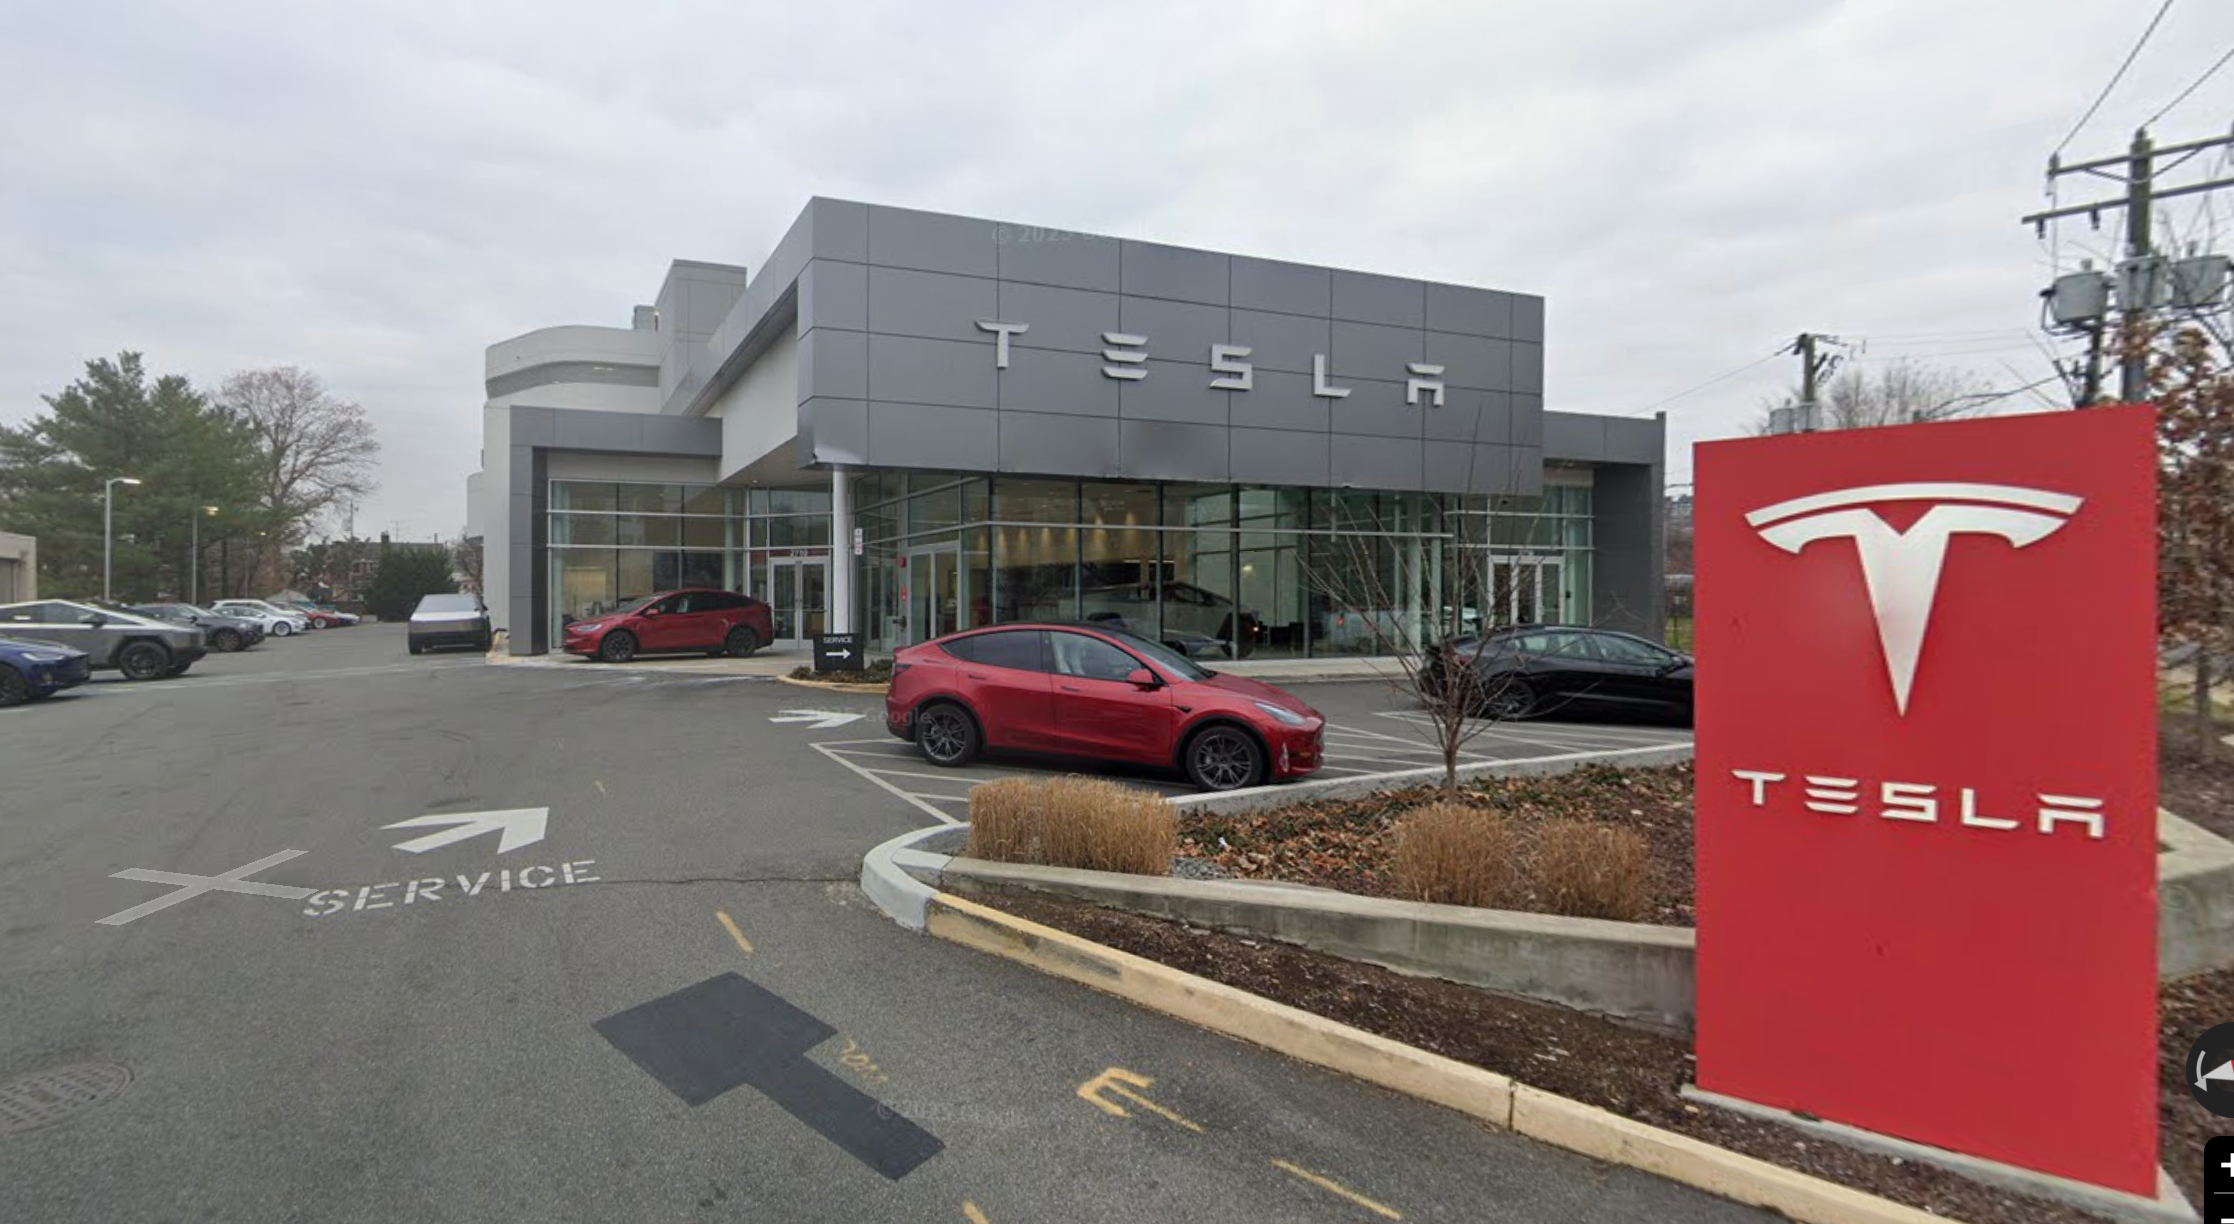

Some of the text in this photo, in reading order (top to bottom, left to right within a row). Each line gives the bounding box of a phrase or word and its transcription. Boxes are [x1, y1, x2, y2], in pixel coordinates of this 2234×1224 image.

[976, 318, 1445, 406] TESLA
[823, 635, 853, 644] SERVICE
[1731, 768, 2104, 838] TESLA
[302, 859, 601, 917] SERVICE
